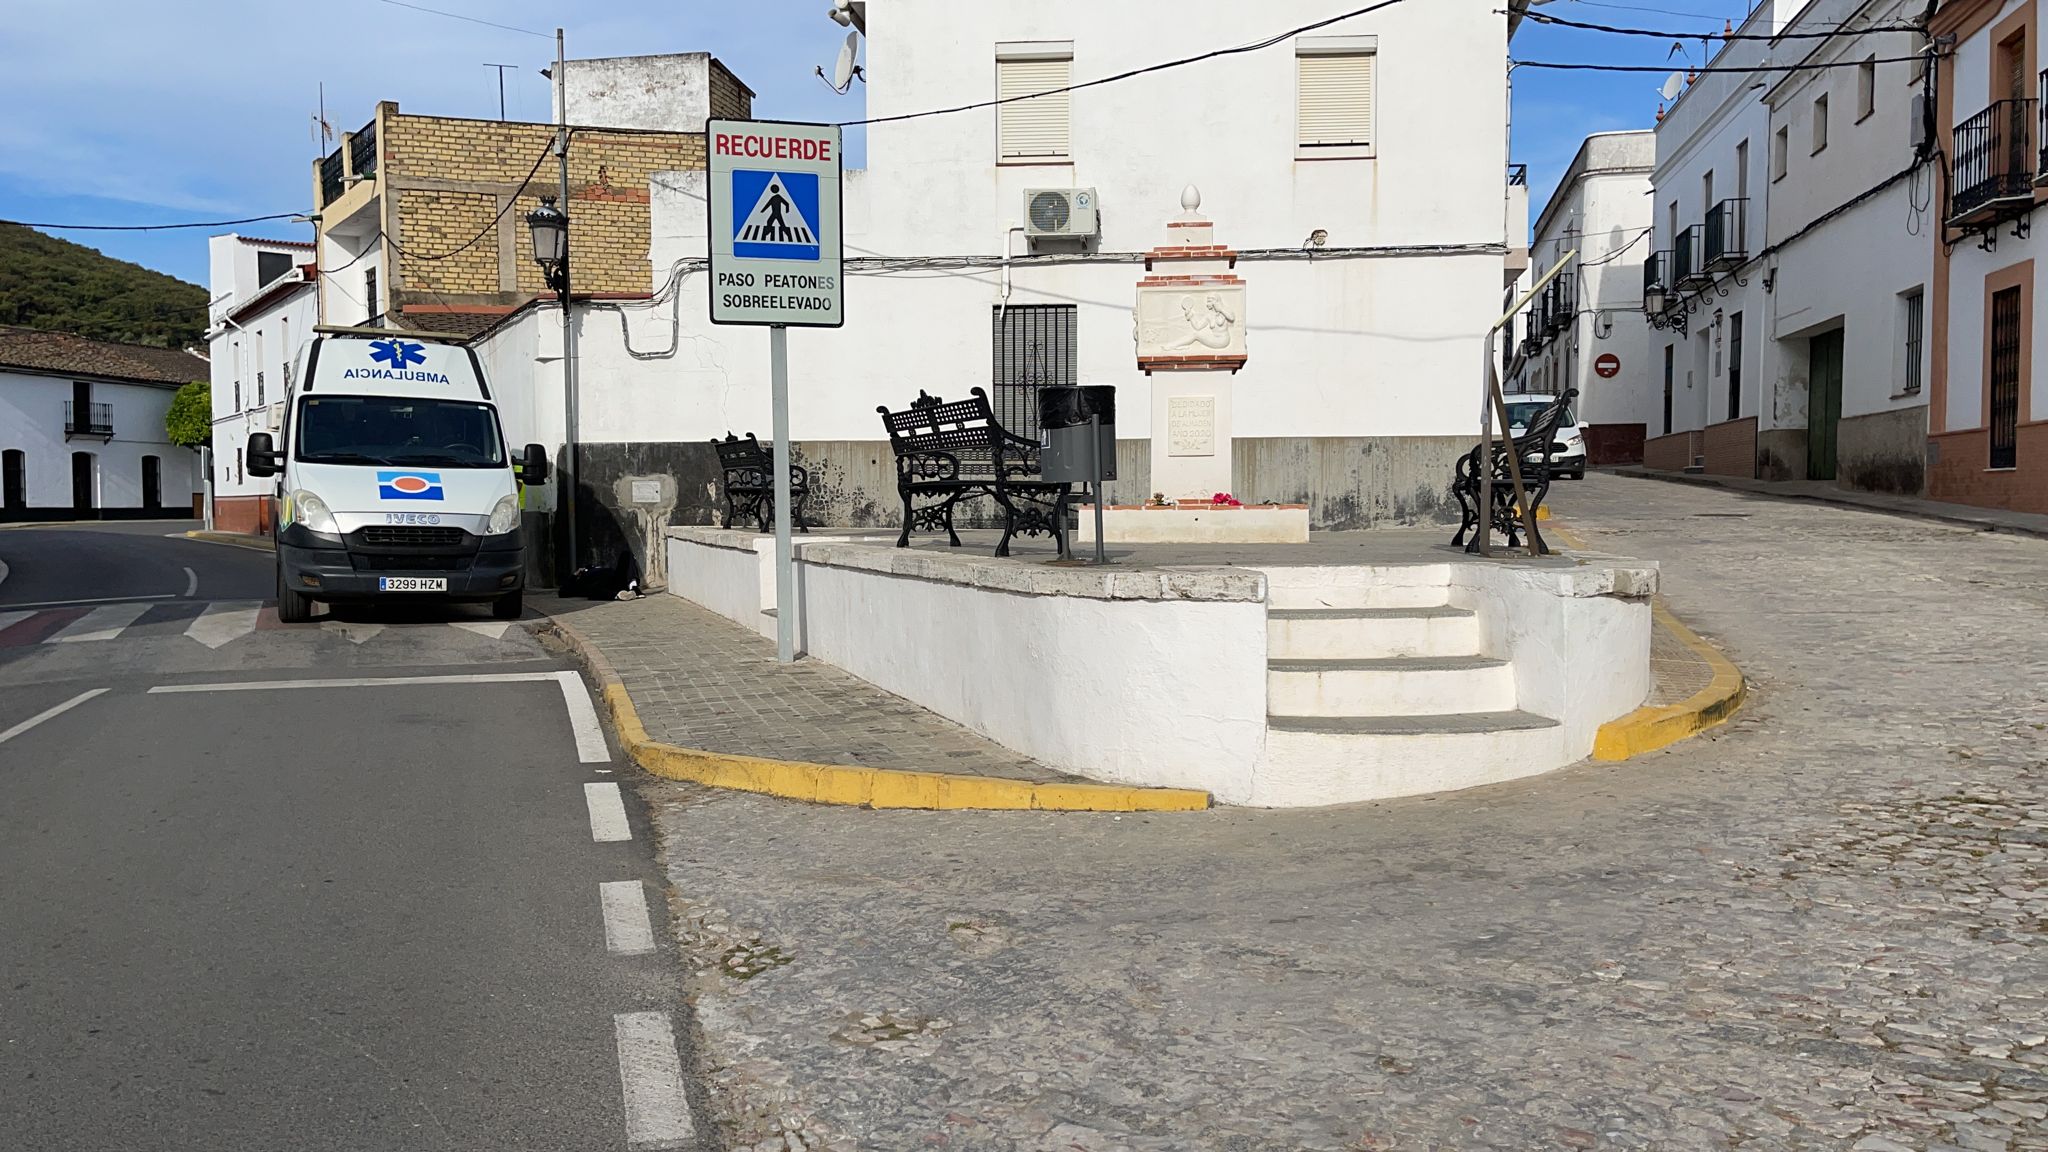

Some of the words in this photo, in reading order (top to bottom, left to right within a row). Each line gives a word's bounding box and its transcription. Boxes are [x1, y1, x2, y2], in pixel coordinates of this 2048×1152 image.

[716, 134, 831, 161] RECUERDE
[719, 273, 755, 287] PASO
[765, 274, 835, 290] PEATONES
[723, 294, 831, 310] SOBREELEVADO
[386, 513, 440, 525] IVECO
[388, 579, 417, 590] 3299
[420, 579, 443, 590] HZM
